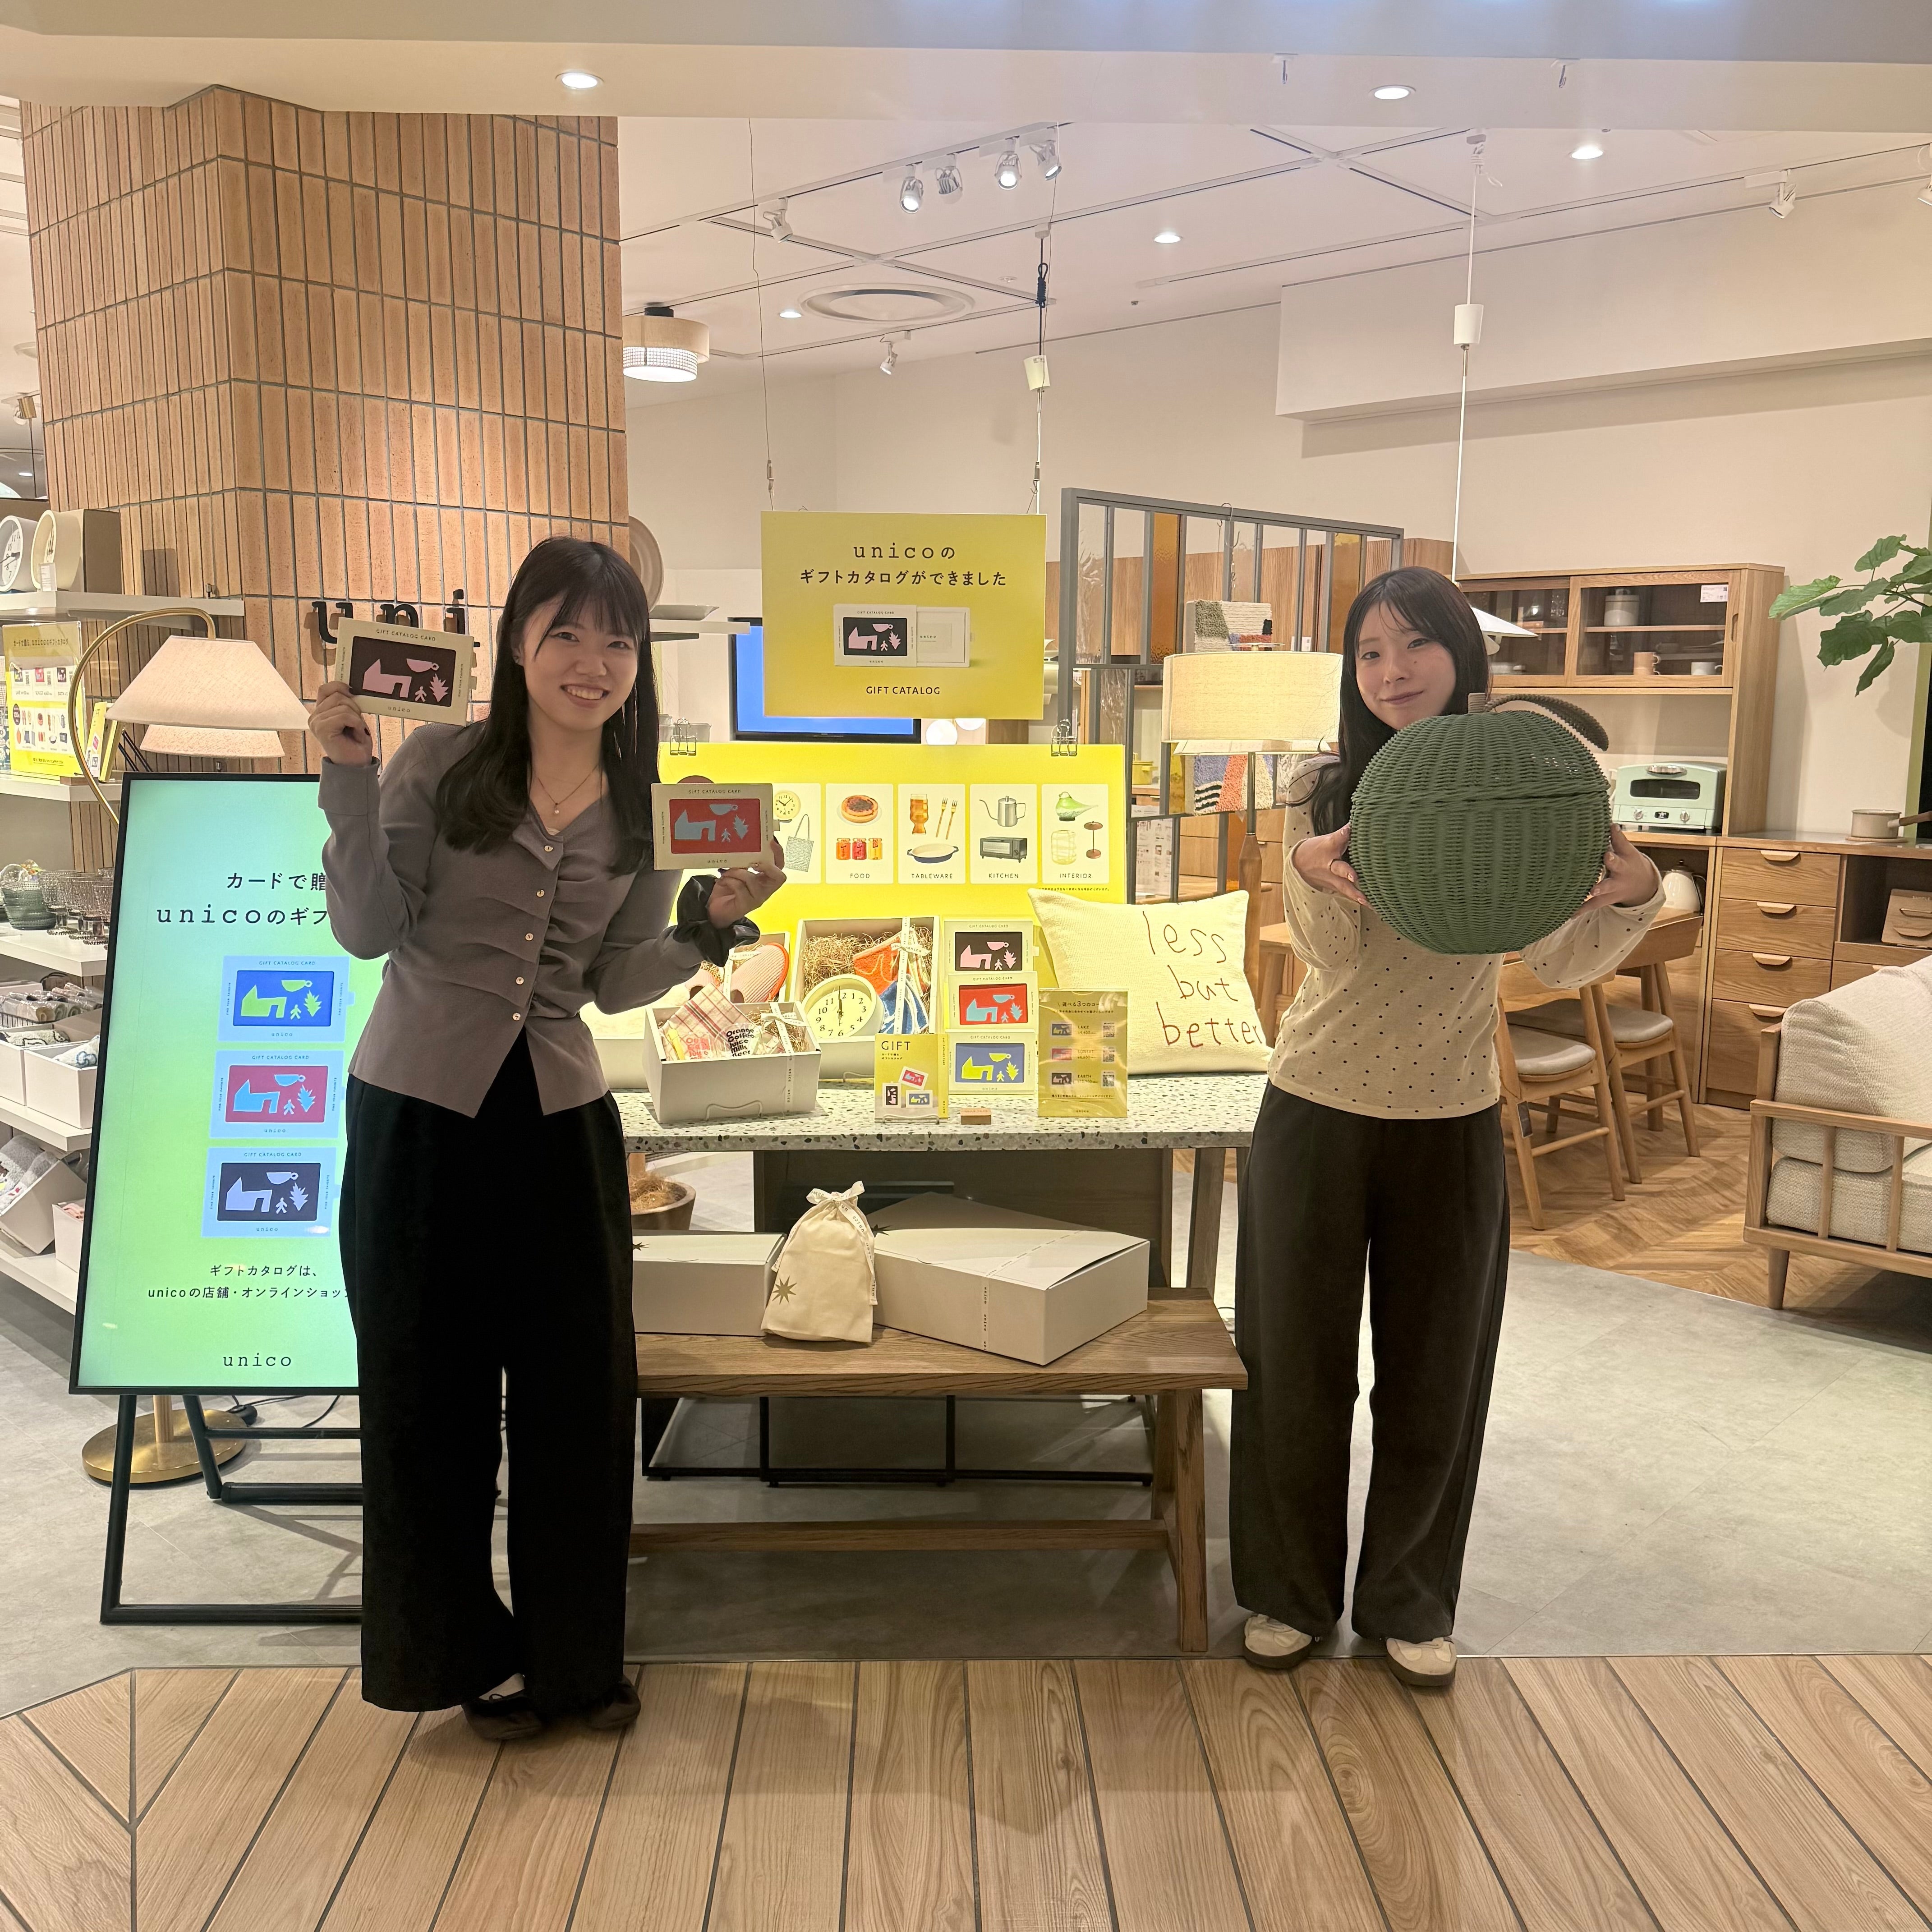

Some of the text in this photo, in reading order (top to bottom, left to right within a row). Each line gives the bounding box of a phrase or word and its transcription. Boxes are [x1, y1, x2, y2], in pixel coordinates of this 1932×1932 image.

[853, 542, 956, 559] unicoの
[800, 569, 1007, 586] ギフトカタログができました
[391, 631, 419, 639] CATALOG
[866, 686, 940, 695] GIFT CATALOG
[227, 872, 326, 891] カードで贈
[157, 904, 327, 925] unicoのギフ
[1142, 911, 1227, 964] less
[1167, 964, 1238, 1002] but
[1156, 1001, 1262, 1048] better
[726, 1028, 754, 1037] Orange
[727, 1033, 755, 1043] Coffee
[730, 1039, 749, 1049] Juice
[731, 1044, 748, 1053] Milk
[881, 1041, 911, 1051] GIFT
[210, 1264, 317, 1277] ギフトカタログは、
[223, 1352, 292, 1367] unico
